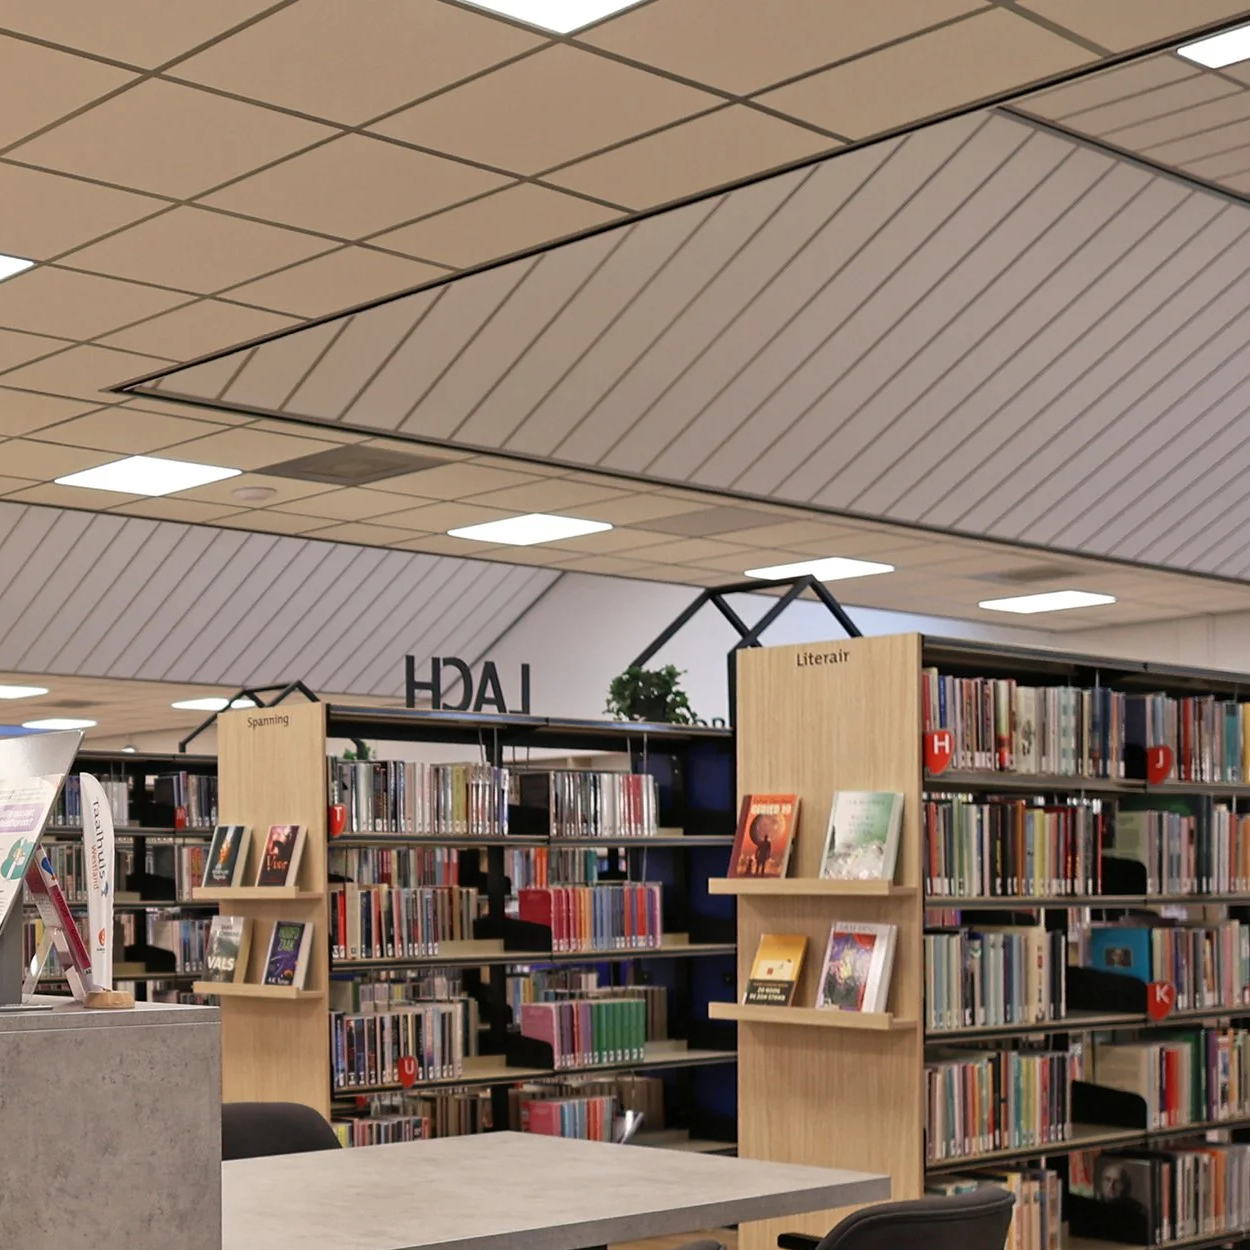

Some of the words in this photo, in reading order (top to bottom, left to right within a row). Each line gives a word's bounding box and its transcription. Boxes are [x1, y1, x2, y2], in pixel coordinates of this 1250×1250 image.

[795, 649, 851, 667] Literair
[247, 714, 289, 730] Spanning
[933, 733, 950, 755] H
[1154, 748, 1164, 769] J
[333, 806, 343, 821] T
[92, 798, 107, 880] Taalhuis
[91, 844, 100, 890] Westland
[207, 955, 235, 971] VALS
[1156, 983, 1170, 1004] K
[404, 1059, 415, 1075] U
